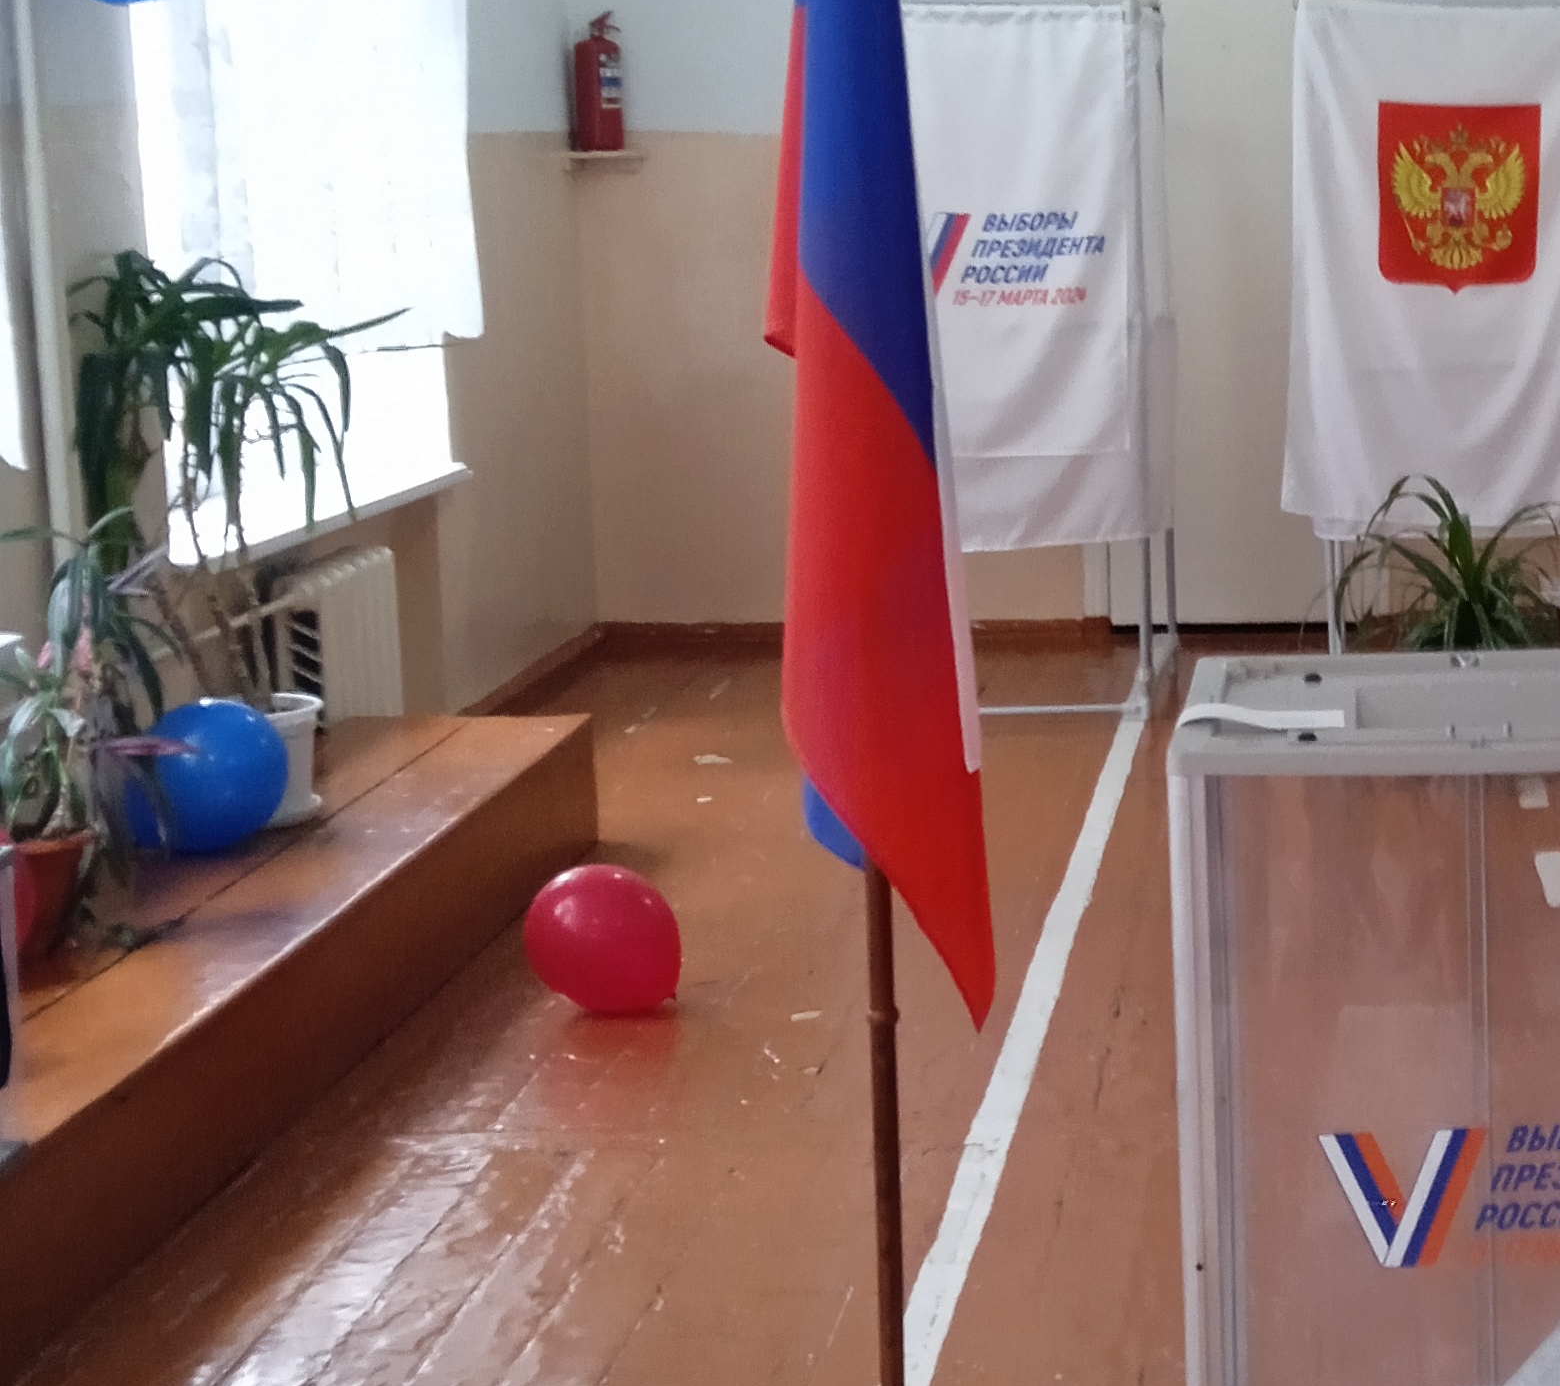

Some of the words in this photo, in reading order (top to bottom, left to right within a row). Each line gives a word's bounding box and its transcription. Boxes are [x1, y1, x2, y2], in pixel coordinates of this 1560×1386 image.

[982, 211, 1078, 232] ВЫБОРЫ
[970, 236, 1105, 259] ПРЕЗИДЕНТА
[961, 264, 1049, 284] РОССИИ
